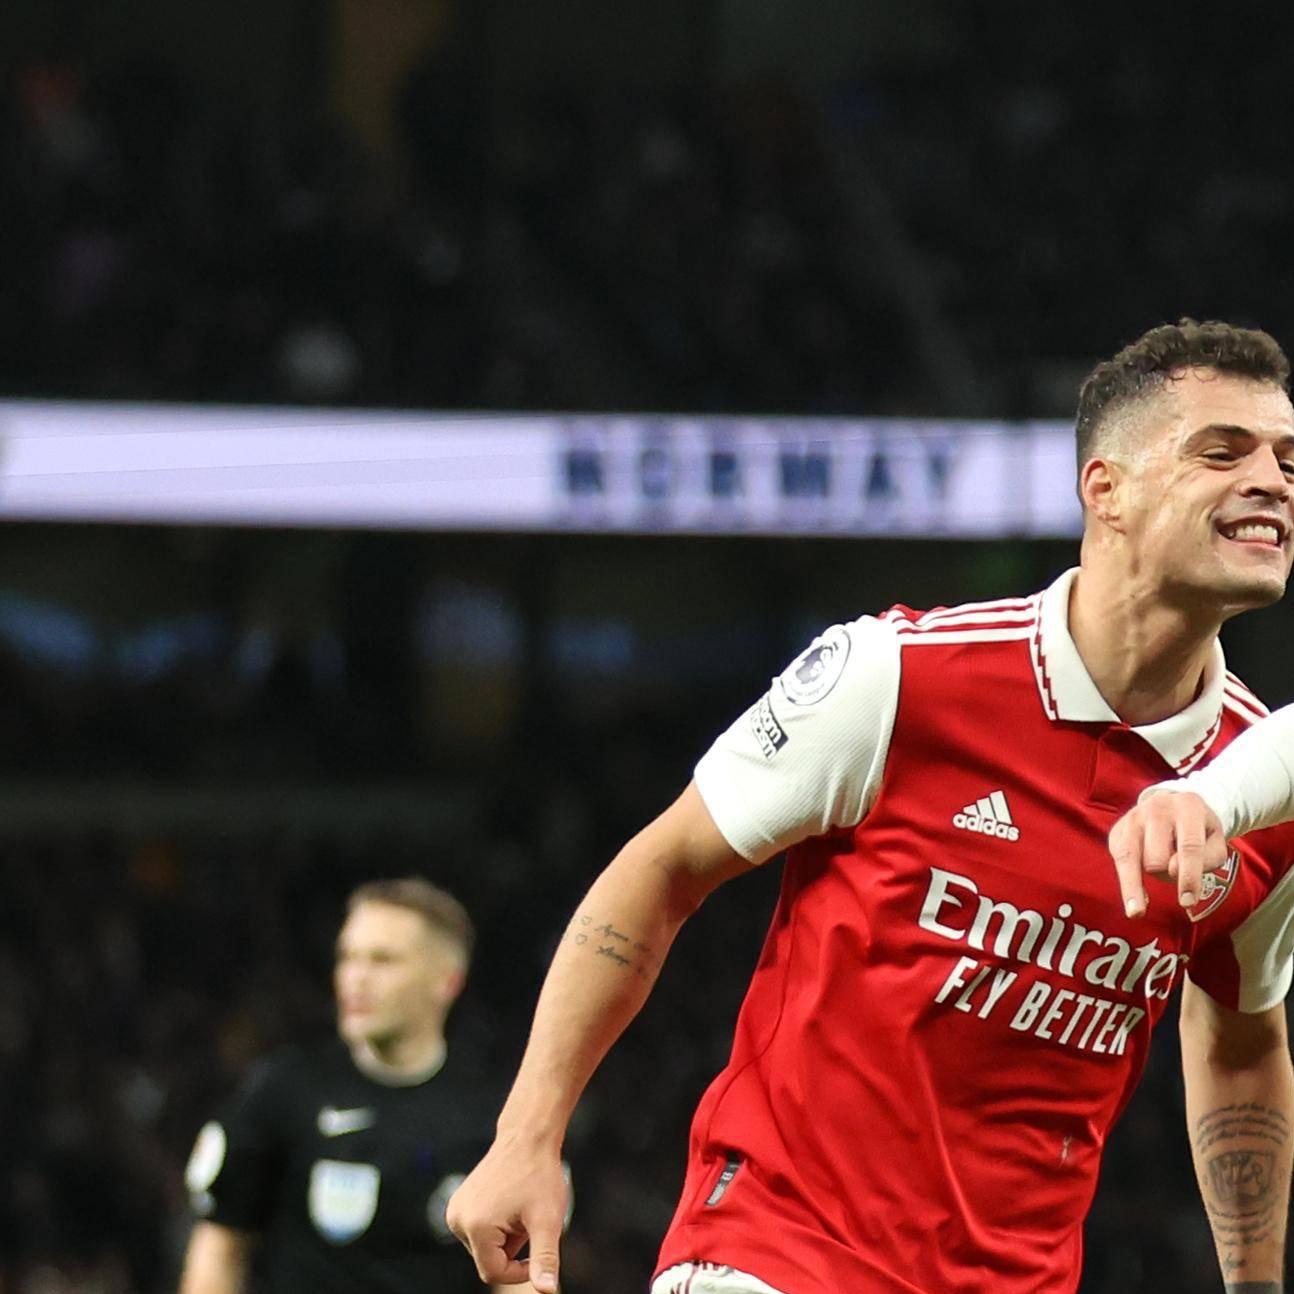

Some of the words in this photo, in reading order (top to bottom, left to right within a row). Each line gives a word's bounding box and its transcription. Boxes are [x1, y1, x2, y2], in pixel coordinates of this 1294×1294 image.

[560, 436, 956, 510] NORWAY
[952, 812, 1020, 842] adidas
[934, 955, 1018, 1020] FLY
[1010, 980, 1145, 1057] BETTER
